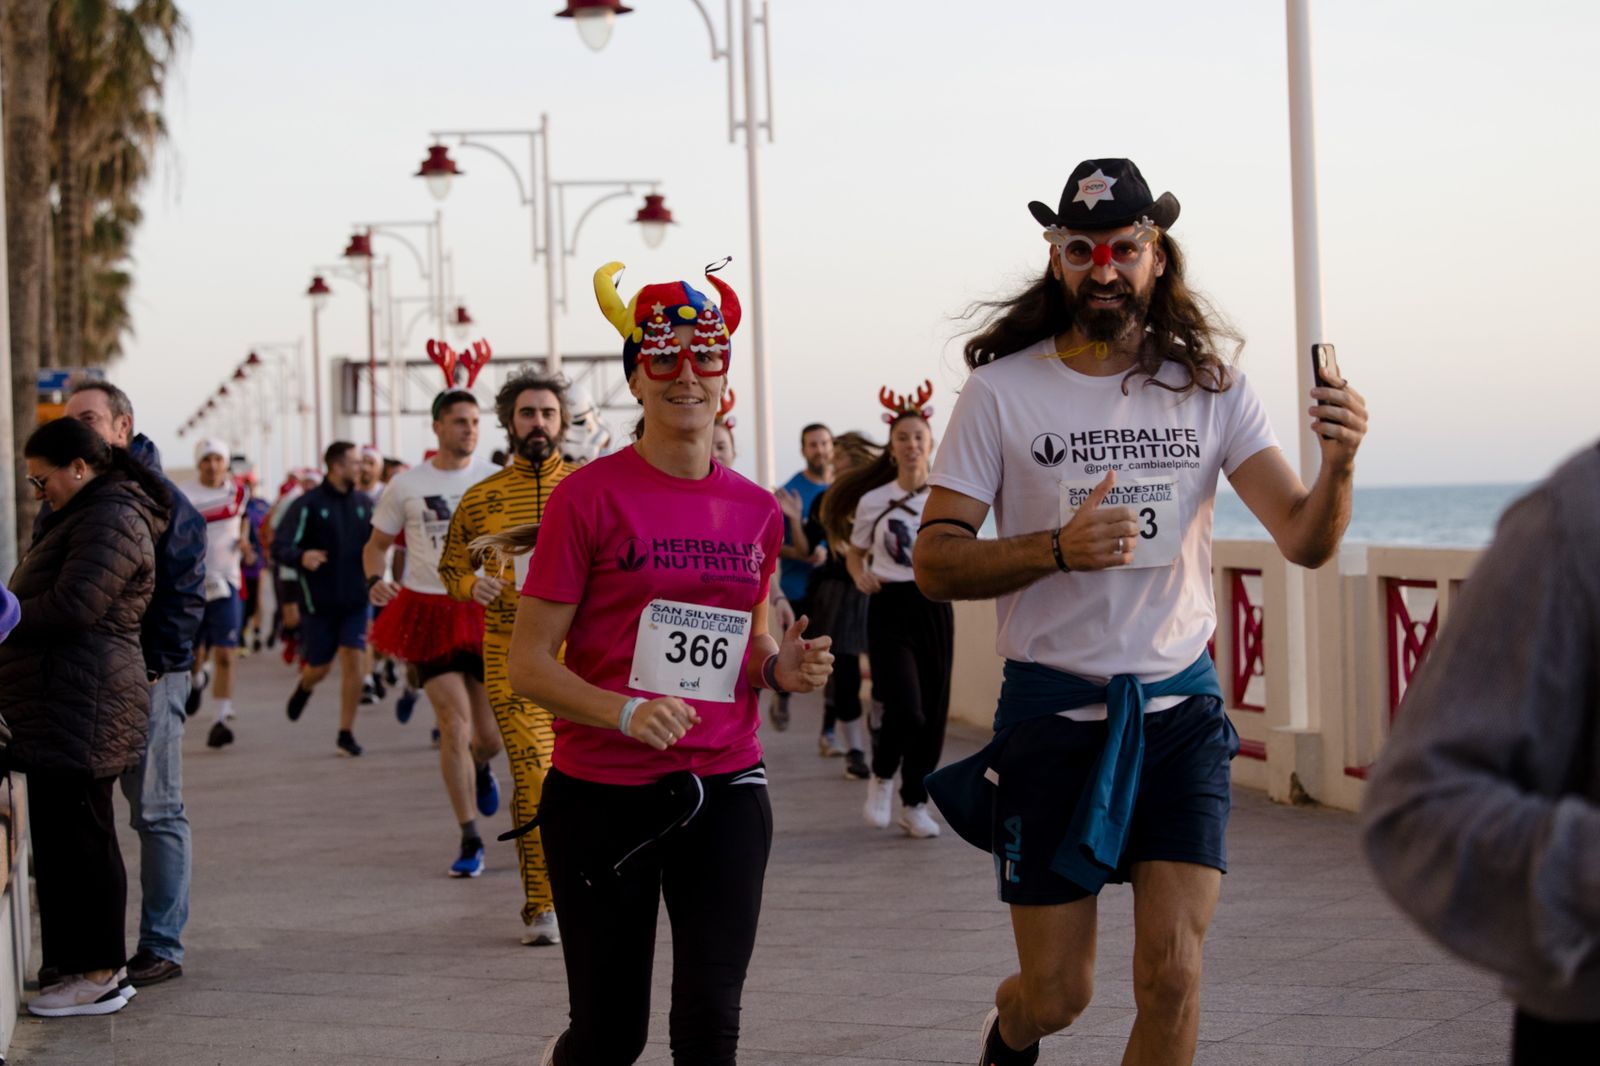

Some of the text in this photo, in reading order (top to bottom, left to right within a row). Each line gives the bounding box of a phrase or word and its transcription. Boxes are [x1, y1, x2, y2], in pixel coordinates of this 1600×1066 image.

[1070, 428, 1198, 446] HERBALIFE
[1072, 444, 1200, 463] NUTRITION
[1108, 484, 1172, 495] ILVESTRE
[1122, 494, 1138, 504] DE
[651, 612, 699, 629] CIUDAD
[701, 620, 715, 631] DE
[665, 631, 729, 669] 366
